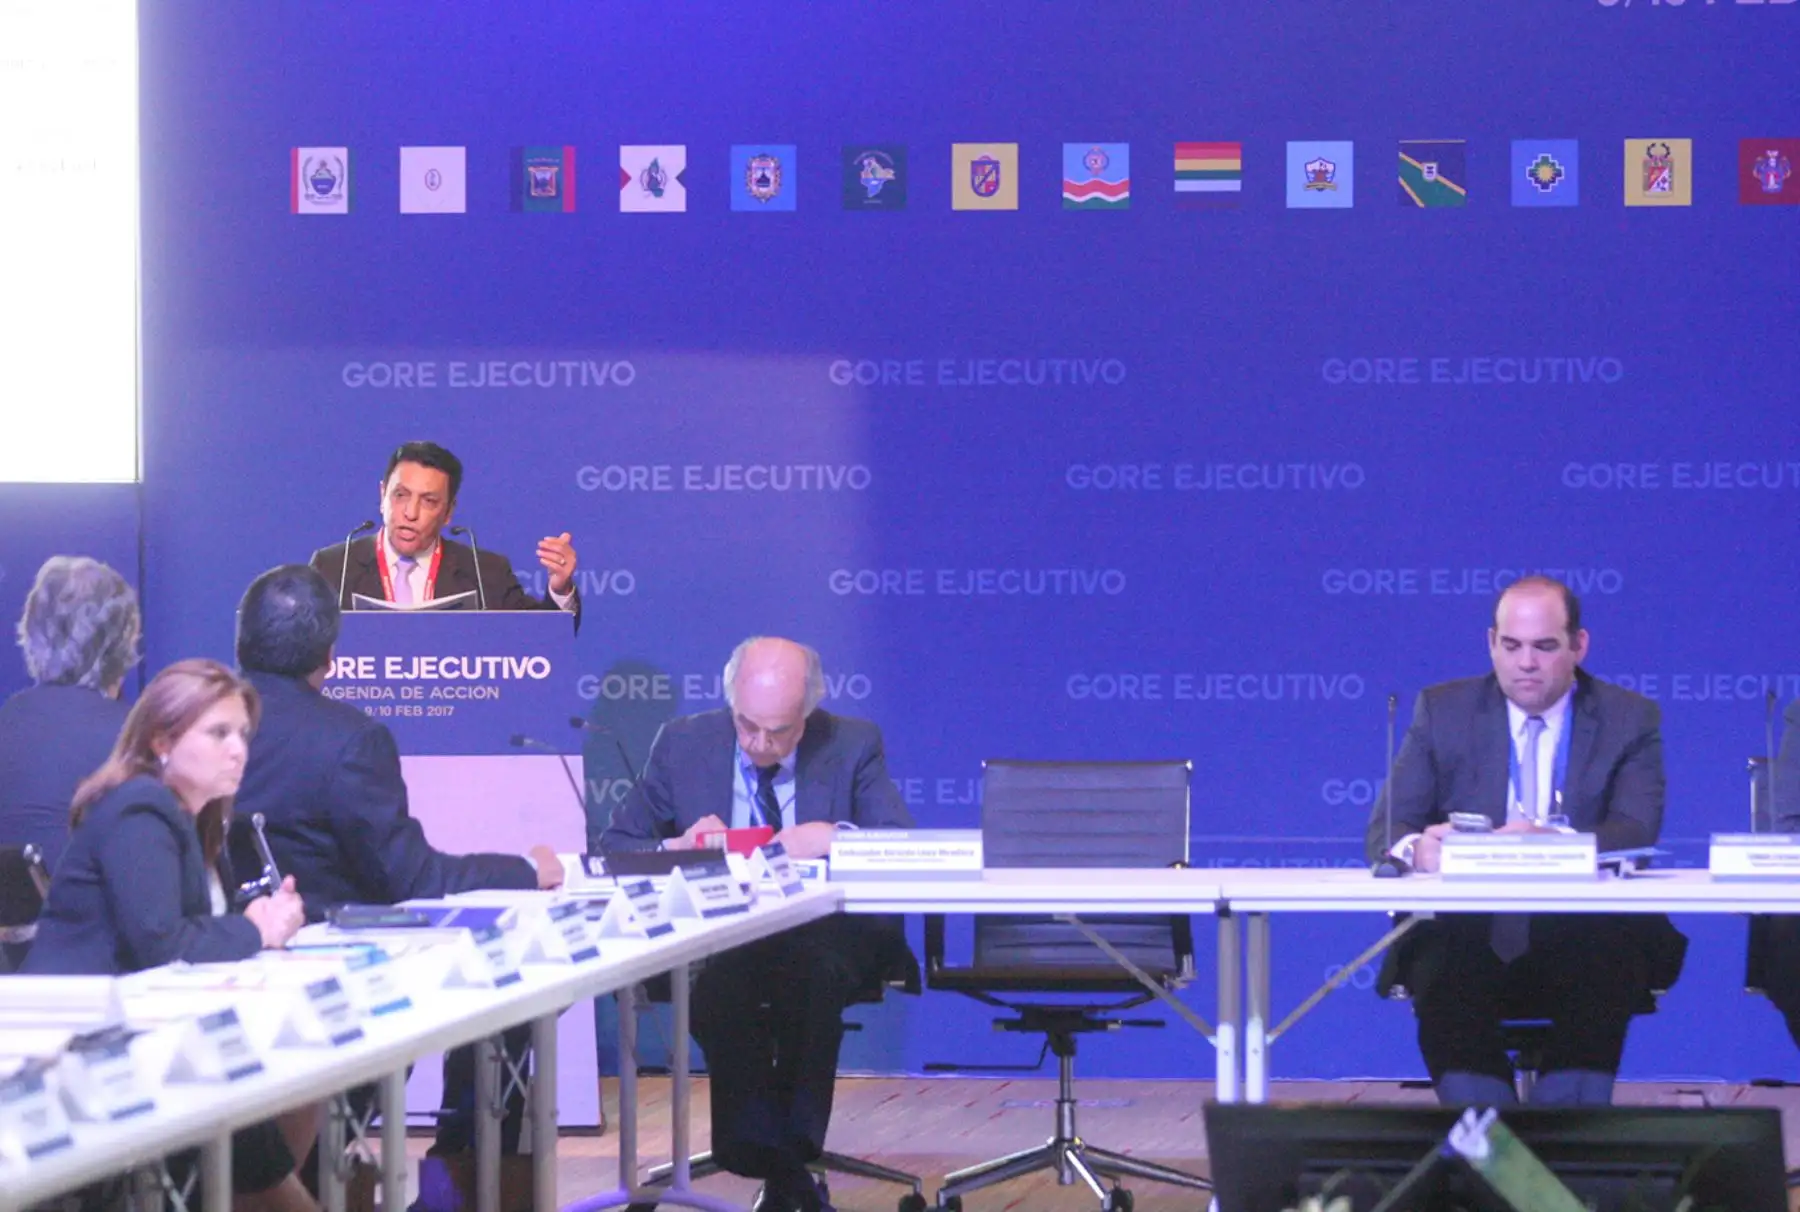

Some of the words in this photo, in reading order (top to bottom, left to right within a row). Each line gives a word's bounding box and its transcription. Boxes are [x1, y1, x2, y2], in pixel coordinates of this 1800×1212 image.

[342, 361, 437, 388] GORE
[448, 360, 636, 387] EJECUTIVO
[829, 360, 924, 386] GORE
[937, 358, 1126, 386] EJECUTIVO
[1322, 359, 1418, 385] GORE
[1431, 356, 1624, 385] EJECUTIVO
[576, 466, 674, 491] GORE
[684, 464, 872, 491] EJECUTIVO
[1066, 464, 1162, 490] GORE
[1175, 462, 1366, 490] EJECUTIVO
[1562, 463, 1659, 489] GORE
[829, 569, 924, 596] GORE
[937, 568, 1126, 596] EJECUTIVO
[1322, 569, 1418, 595] GORE
[385, 656, 551, 680] EJECUTIVO
[321, 686, 396, 700] AGENDA
[400, 686, 425, 700] DE
[576, 674, 672, 700] GORE
[1066, 674, 1162, 700] GORE
[1175, 673, 1365, 700] EJECUTIVO
[364, 705, 392, 717] 9/10
[395, 705, 423, 717] FEB
[426, 705, 455, 717] 2017
